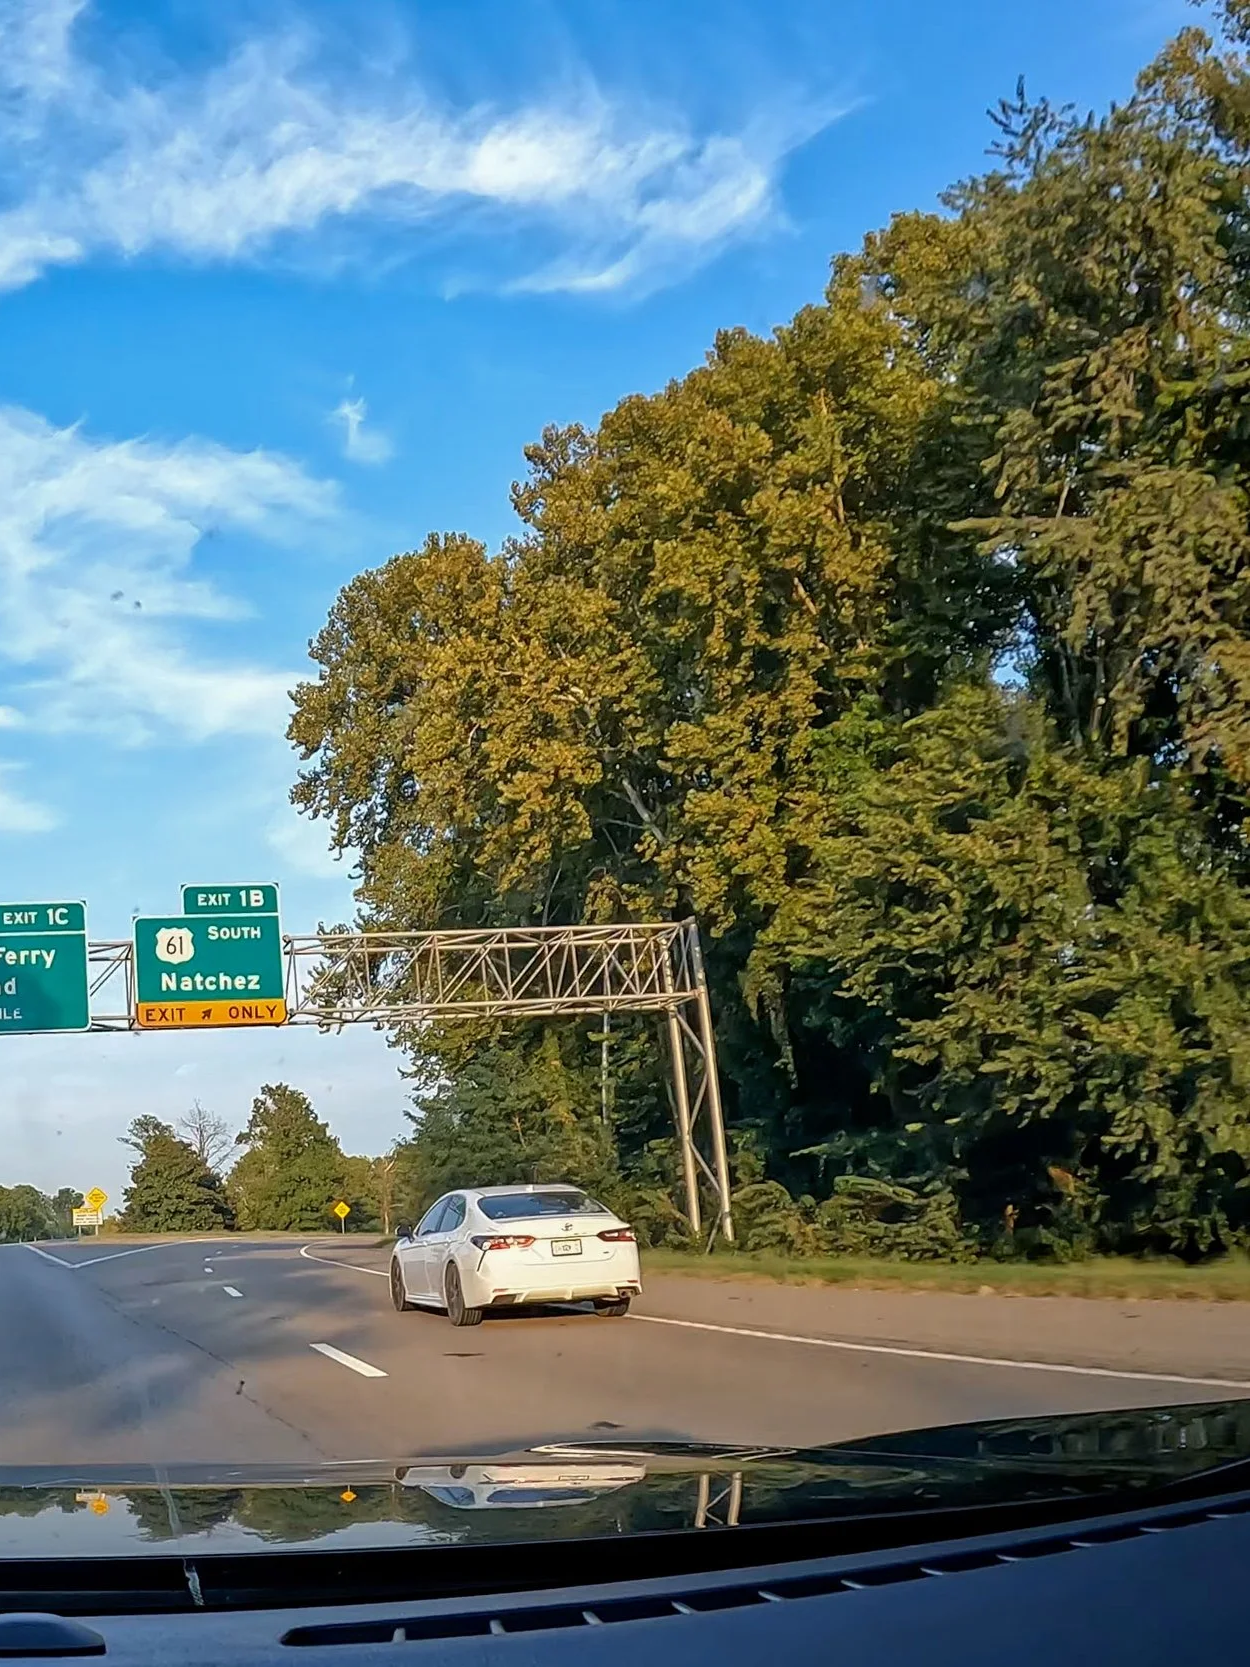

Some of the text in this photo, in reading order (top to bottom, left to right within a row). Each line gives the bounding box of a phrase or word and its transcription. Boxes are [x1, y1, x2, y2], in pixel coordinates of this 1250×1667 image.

[197, 889, 264, 907] EXIT 1B
[3, 907, 69, 926] EXIT 1C
[207, 925, 261, 940] SOUTH
[166, 936, 183, 955] 61
[161, 972, 260, 991] Natchez
[145, 1005, 277, 1022] EXIT ONLY
